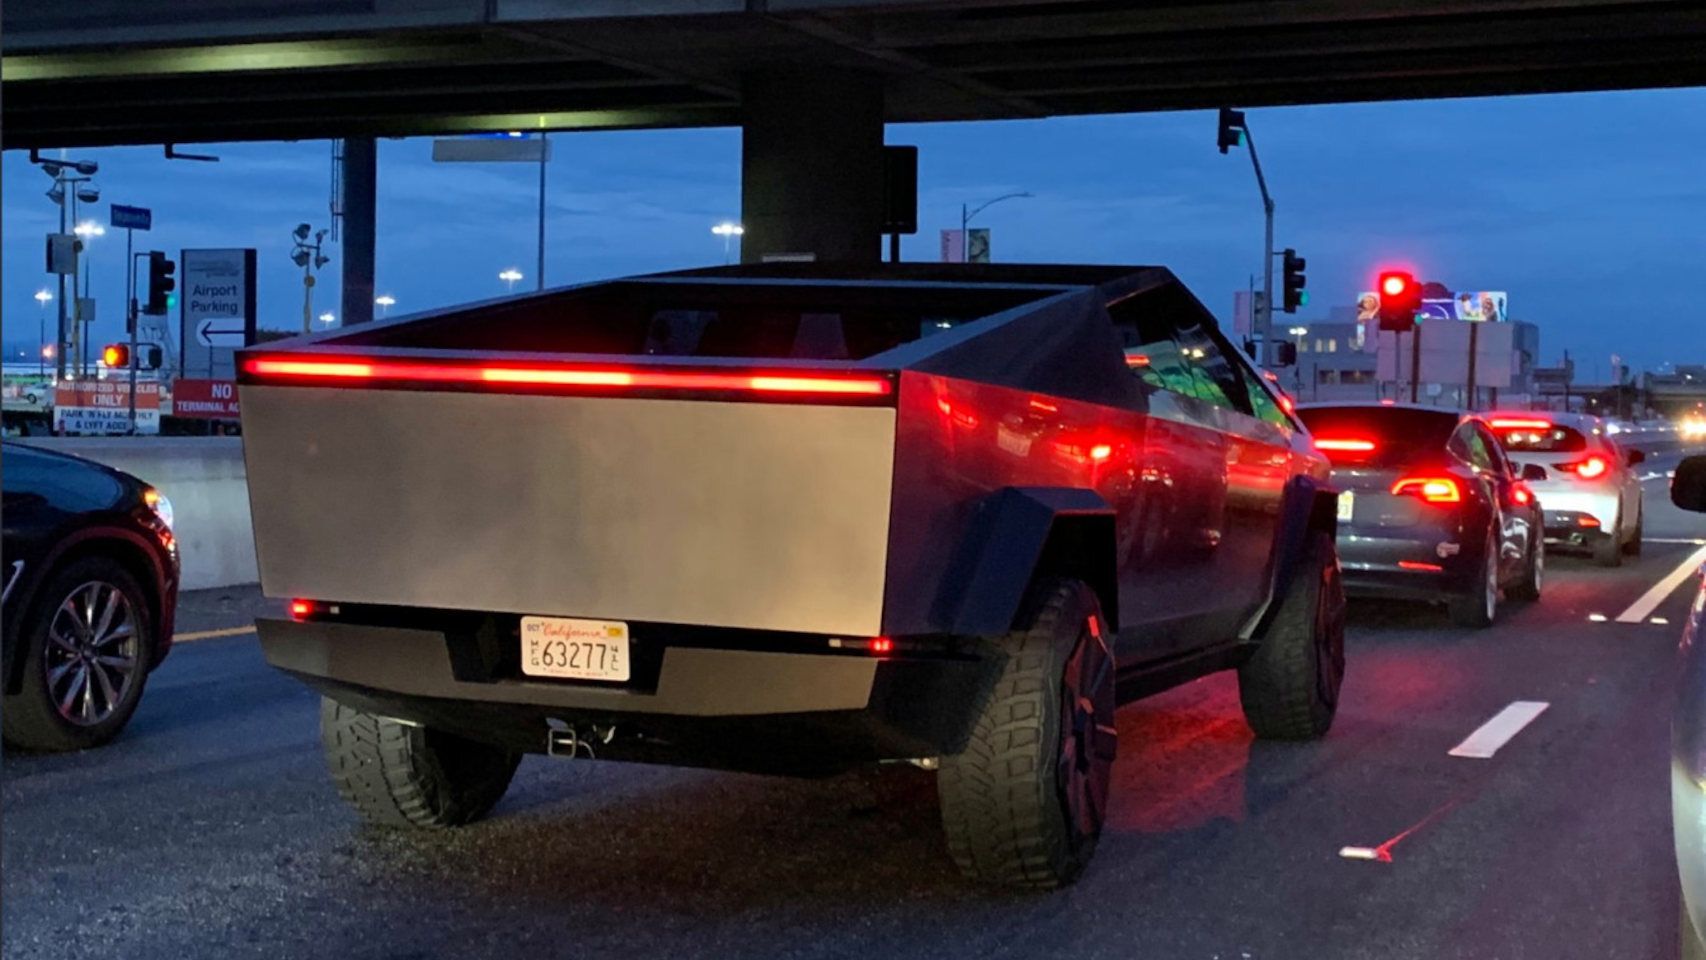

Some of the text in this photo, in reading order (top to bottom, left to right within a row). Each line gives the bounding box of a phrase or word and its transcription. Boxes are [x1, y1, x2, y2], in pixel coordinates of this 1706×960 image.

[192, 284, 238, 298] Airport
[191, 300, 239, 316] Parking
[116, 383, 158, 394] VEHCLES
[211, 384, 232, 399] NO
[92, 393, 123, 407] ONLY
[177, 401, 226, 413] TERMINAL
[543, 621, 601, 641] California
[542, 641, 607, 670] 63277
